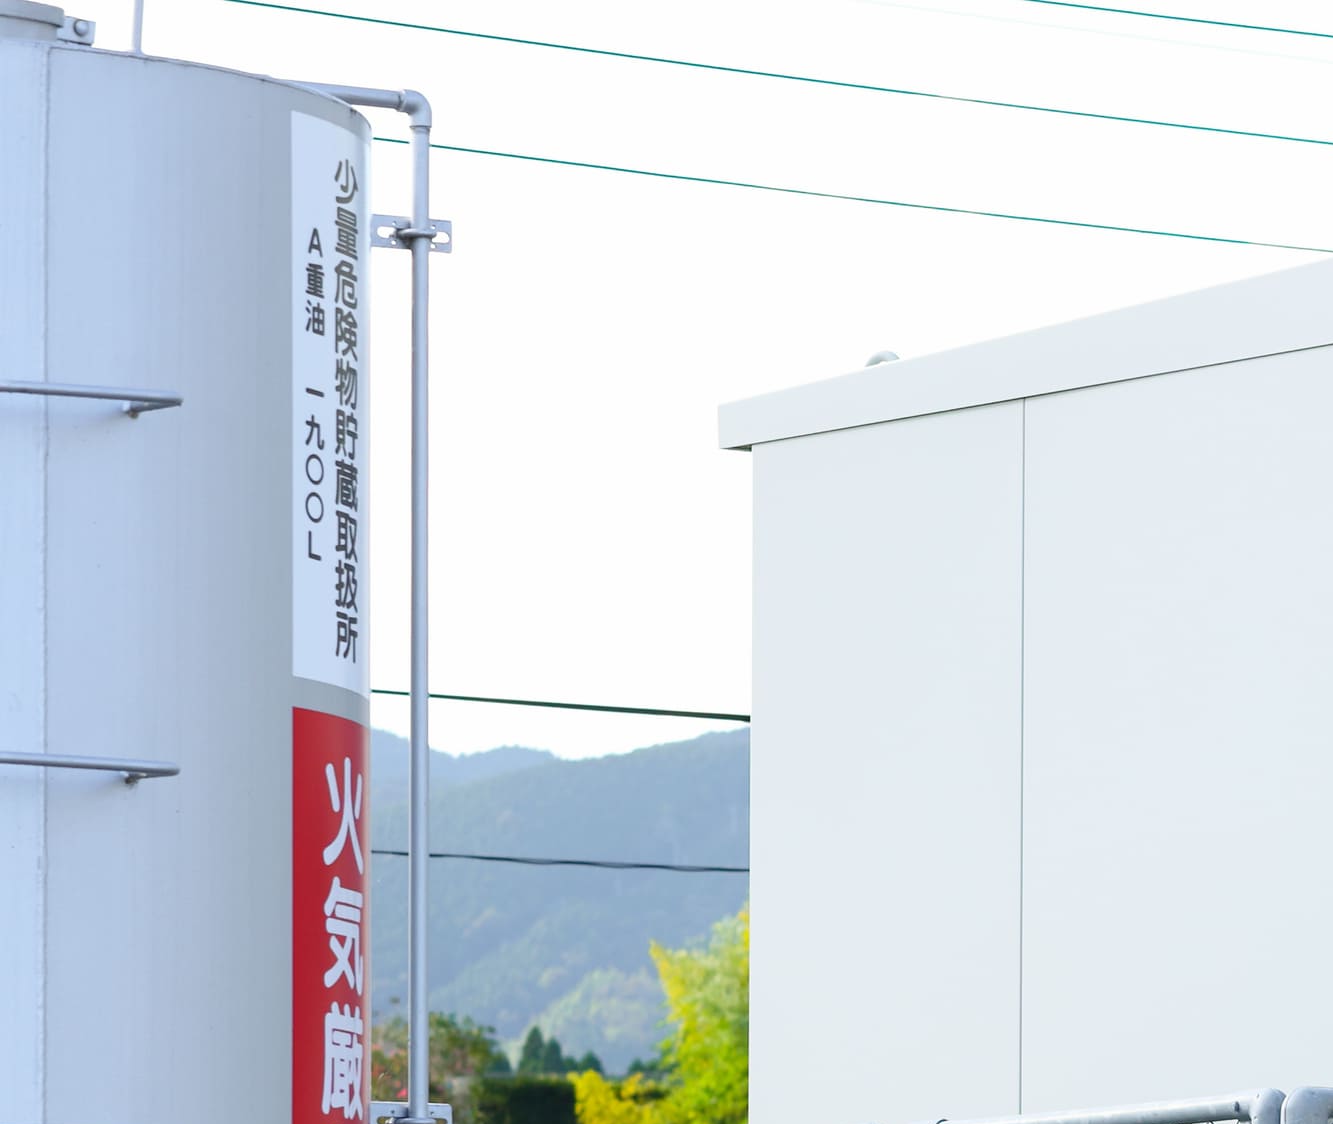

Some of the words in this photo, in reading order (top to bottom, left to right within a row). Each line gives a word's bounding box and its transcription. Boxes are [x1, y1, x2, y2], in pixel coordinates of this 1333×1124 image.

[334, 159, 359, 664] 少量危険物貯蔵取扱所
